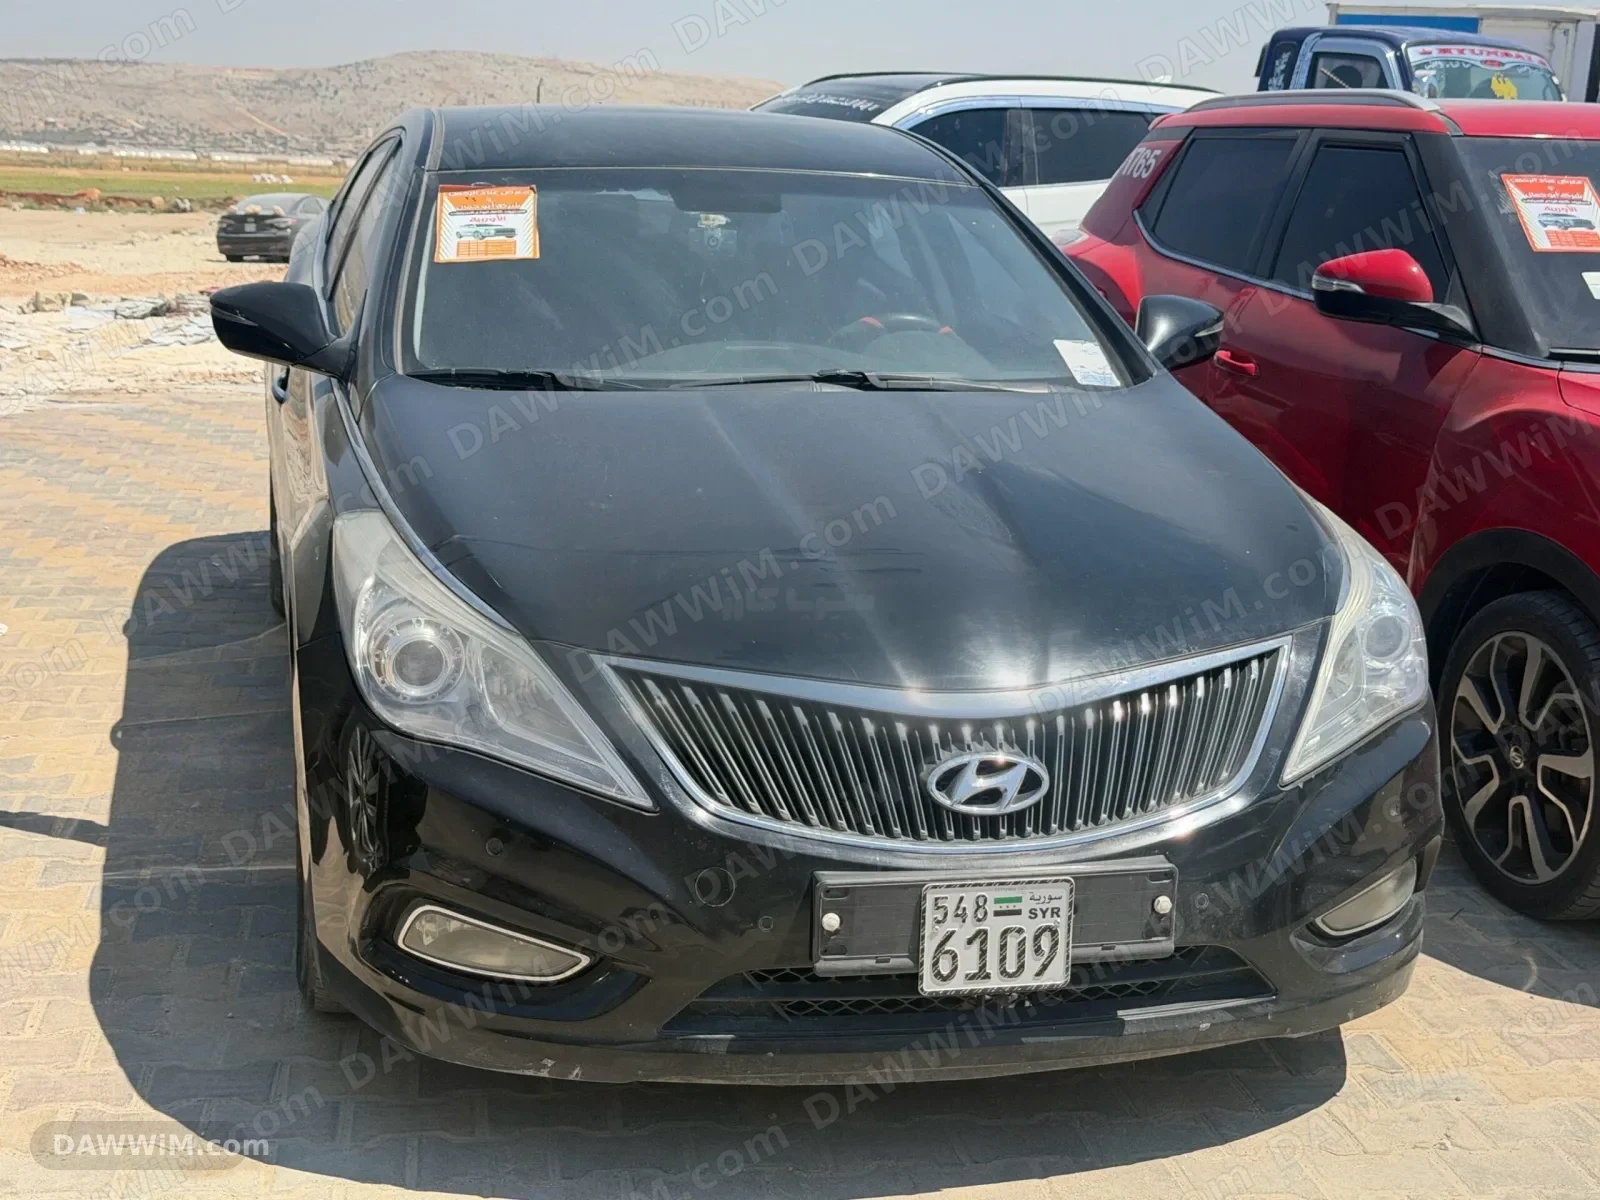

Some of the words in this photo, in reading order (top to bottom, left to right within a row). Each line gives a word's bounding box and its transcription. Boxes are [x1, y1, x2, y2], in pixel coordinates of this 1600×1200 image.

[932, 893, 989, 925] 548
[1029, 891, 1063, 906] سورية
[1028, 906, 1062, 920] SYR
[931, 925, 1061, 983] 6109
